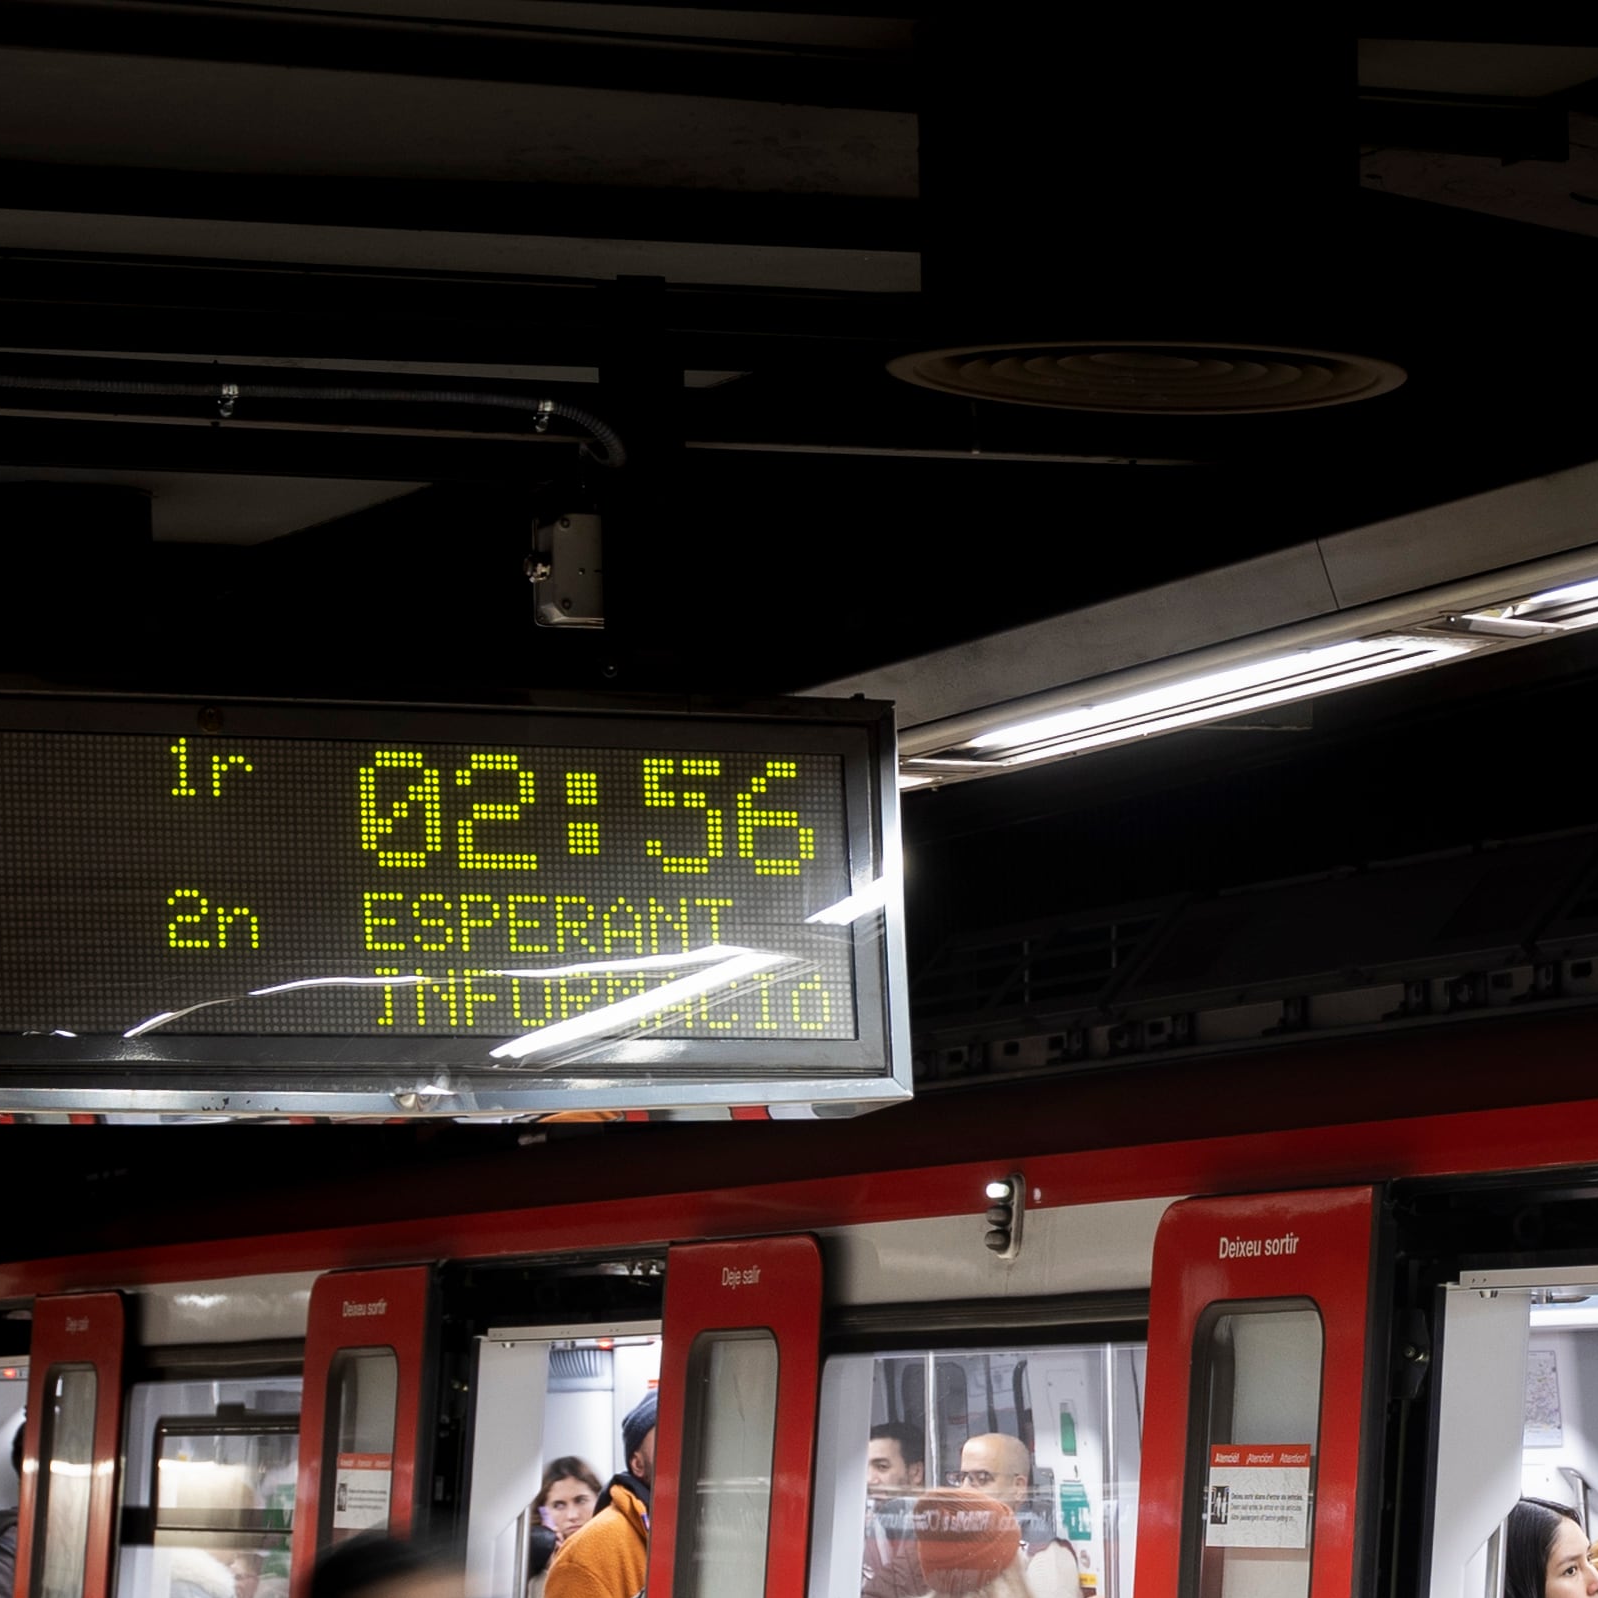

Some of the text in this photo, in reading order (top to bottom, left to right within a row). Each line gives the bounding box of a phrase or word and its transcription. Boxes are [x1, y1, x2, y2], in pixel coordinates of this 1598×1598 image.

[169, 738, 814, 875] 1r 02:56
[167, 889, 733, 954] 2n ESPERANT
[1219, 1232, 1299, 1259] Deixeu sortir
